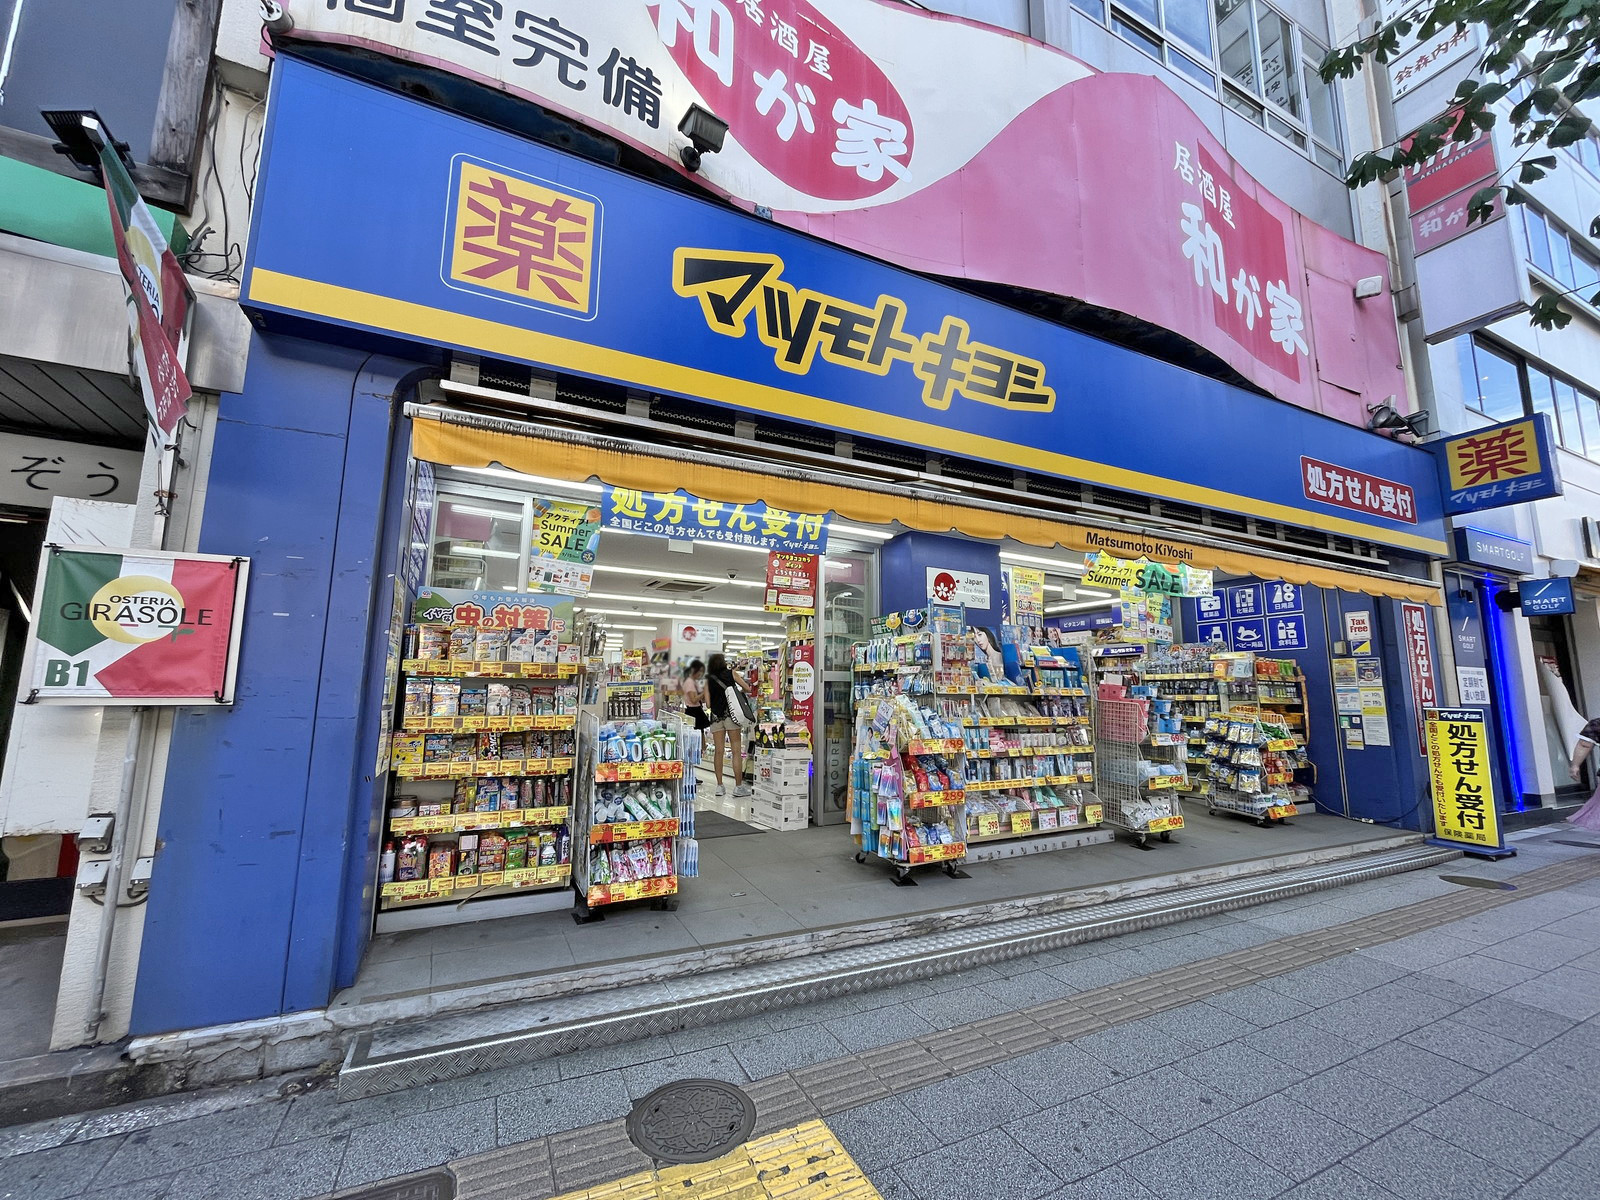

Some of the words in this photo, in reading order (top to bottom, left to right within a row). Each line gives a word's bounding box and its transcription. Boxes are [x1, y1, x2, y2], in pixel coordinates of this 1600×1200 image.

[1420, 148, 1474, 180] AKIHABARA
[1173, 141, 1237, 230] 居酒屋
[462, 176, 588, 305] 薬
[1179, 202, 1309, 356] 和が家
[674, 248, 1055, 411] マツモトキヨシ
[1457, 428, 1528, 487] 薬
[1307, 463, 1413, 520] 処方せん受付
[1450, 478, 1546, 504] マツモトキヨシ
[610, 487, 825, 541] 処方せん受付
[541, 519, 591, 537] Summer
[609, 516, 782, 548] 全国どこの処方せんでも受付致します。
[539, 532, 586, 552] SALE
[1085, 531, 1154, 554] Matsumoto
[1154, 543, 1194, 561] KiYoshi
[965, 577, 984, 586] Japan
[1087, 570, 1131, 588] Summer
[1134, 568, 1181, 593] SALE
[109, 595, 176, 606] OSTERIA
[971, 595, 986, 604] Shop
[1274, 602, 1295, 610] 日用品
[1524, 596, 1567, 606] SMART
[1532, 602, 1560, 611] GOLF
[60, 601, 214, 626] GIRASOLE
[1350, 618, 1365, 626] Tax
[1350, 625, 1368, 633] Free
[1235, 641, 1264, 649] ベビー用品
[1278, 639, 1299, 647] 食料品
[1458, 635, 1476, 643] SMART
[44, 659, 90, 687] B1
[943, 739, 964, 749] 289
[649, 763, 682, 774] 198
[1447, 723, 1487, 830] 処方せん受付
[943, 791, 964, 801] 289
[642, 820, 678, 834] 228
[1168, 817, 1183, 826] 600
[942, 844, 964, 854] 289
